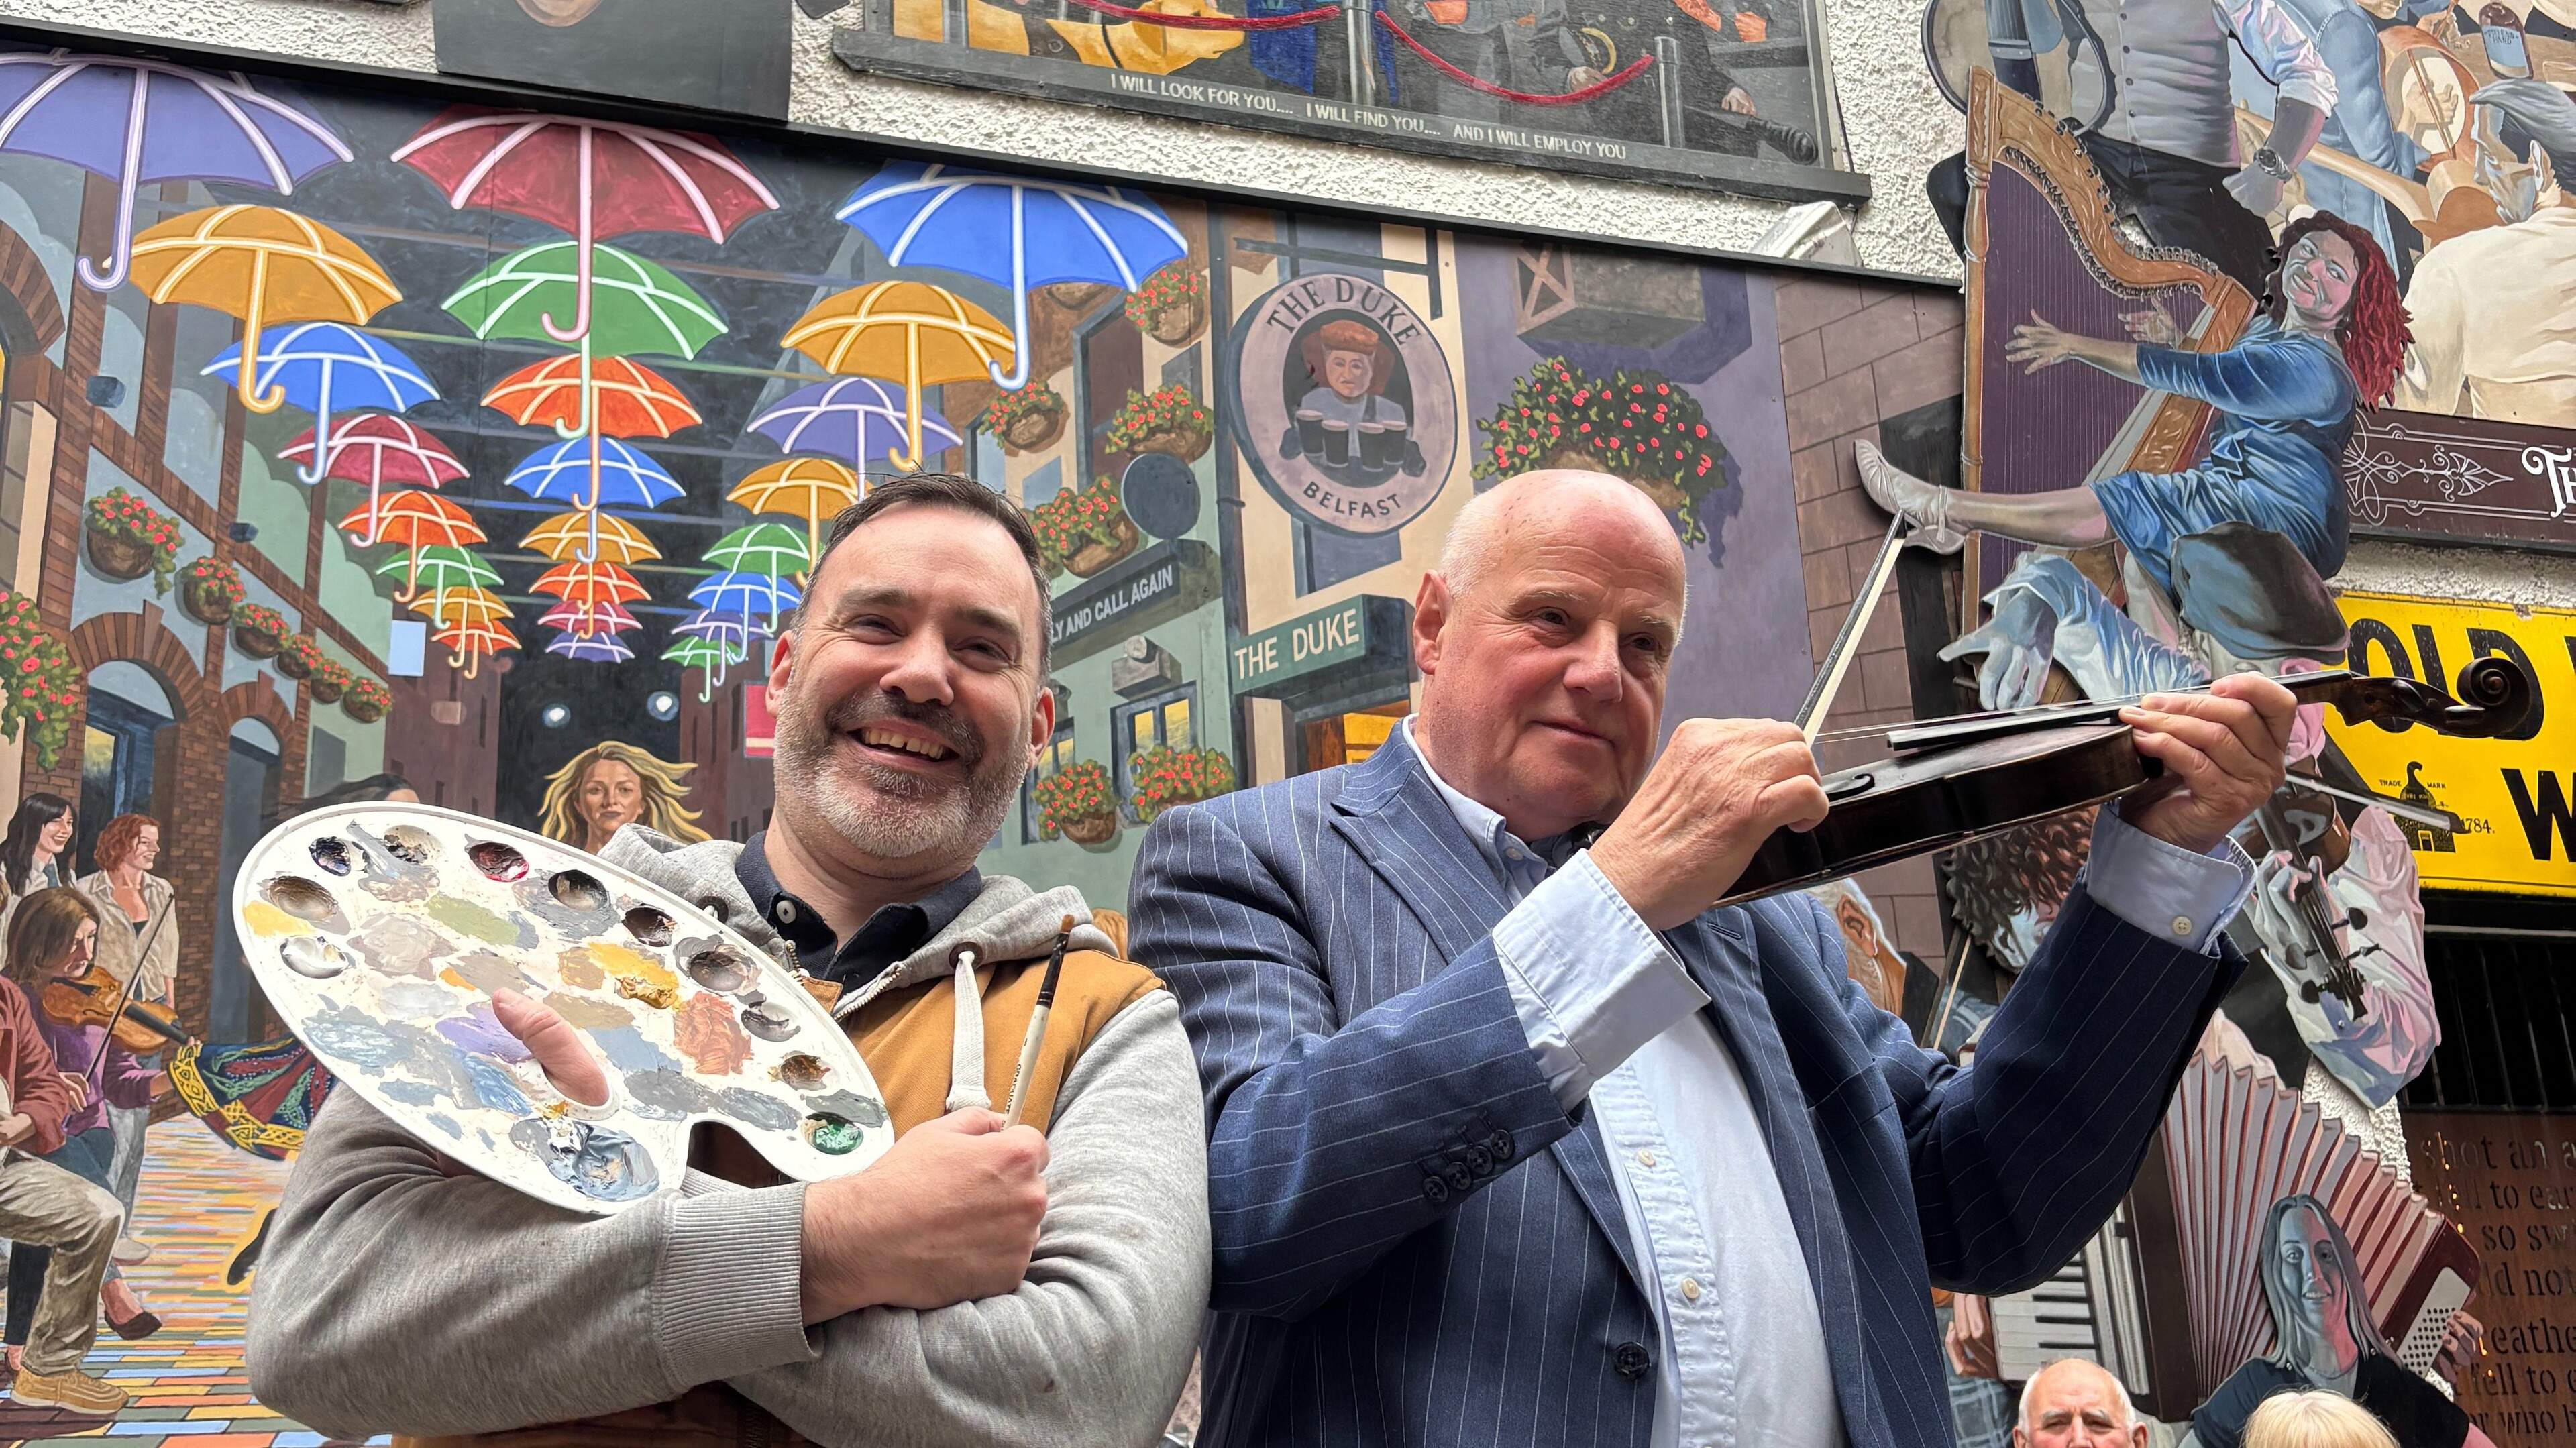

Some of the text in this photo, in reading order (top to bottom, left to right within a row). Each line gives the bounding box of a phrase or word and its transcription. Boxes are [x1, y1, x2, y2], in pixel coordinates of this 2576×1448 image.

[1111, 74, 1116, 89] I
[1120, 76, 1157, 95] WILL
[1161, 80, 1205, 102] LOOK
[1208, 87, 1240, 107] FOR
[1306, 102, 1312, 118] I
[1315, 105, 1351, 123] WILL
[1354, 109, 1389, 128] FIND
[1453, 123, 1485, 142] AND
[1487, 128, 1493, 144] I
[1495, 129, 1531, 148] WILL
[1534, 134, 1593, 156] EMPLOY
[1594, 142, 1627, 160] YOU
[1266, 276, 1421, 347] THE DUKE
[1303, 480, 1404, 519] BELFAST
[1065, 607, 1092, 638] AND
[1094, 590, 1129, 622] CALL
[1130, 564, 1173, 606] AGAIN
[1234, 608, 1361, 681] THE DUKE
[2427, 782, 2447, 790] MARK
[2508, 1140, 2548, 1170] an
[2489, 1181, 2520, 1210] to
[2481, 1225, 2516, 1252] so
[2526, 1366, 2557, 1396] to
[2498, 1406, 2556, 1434] who
